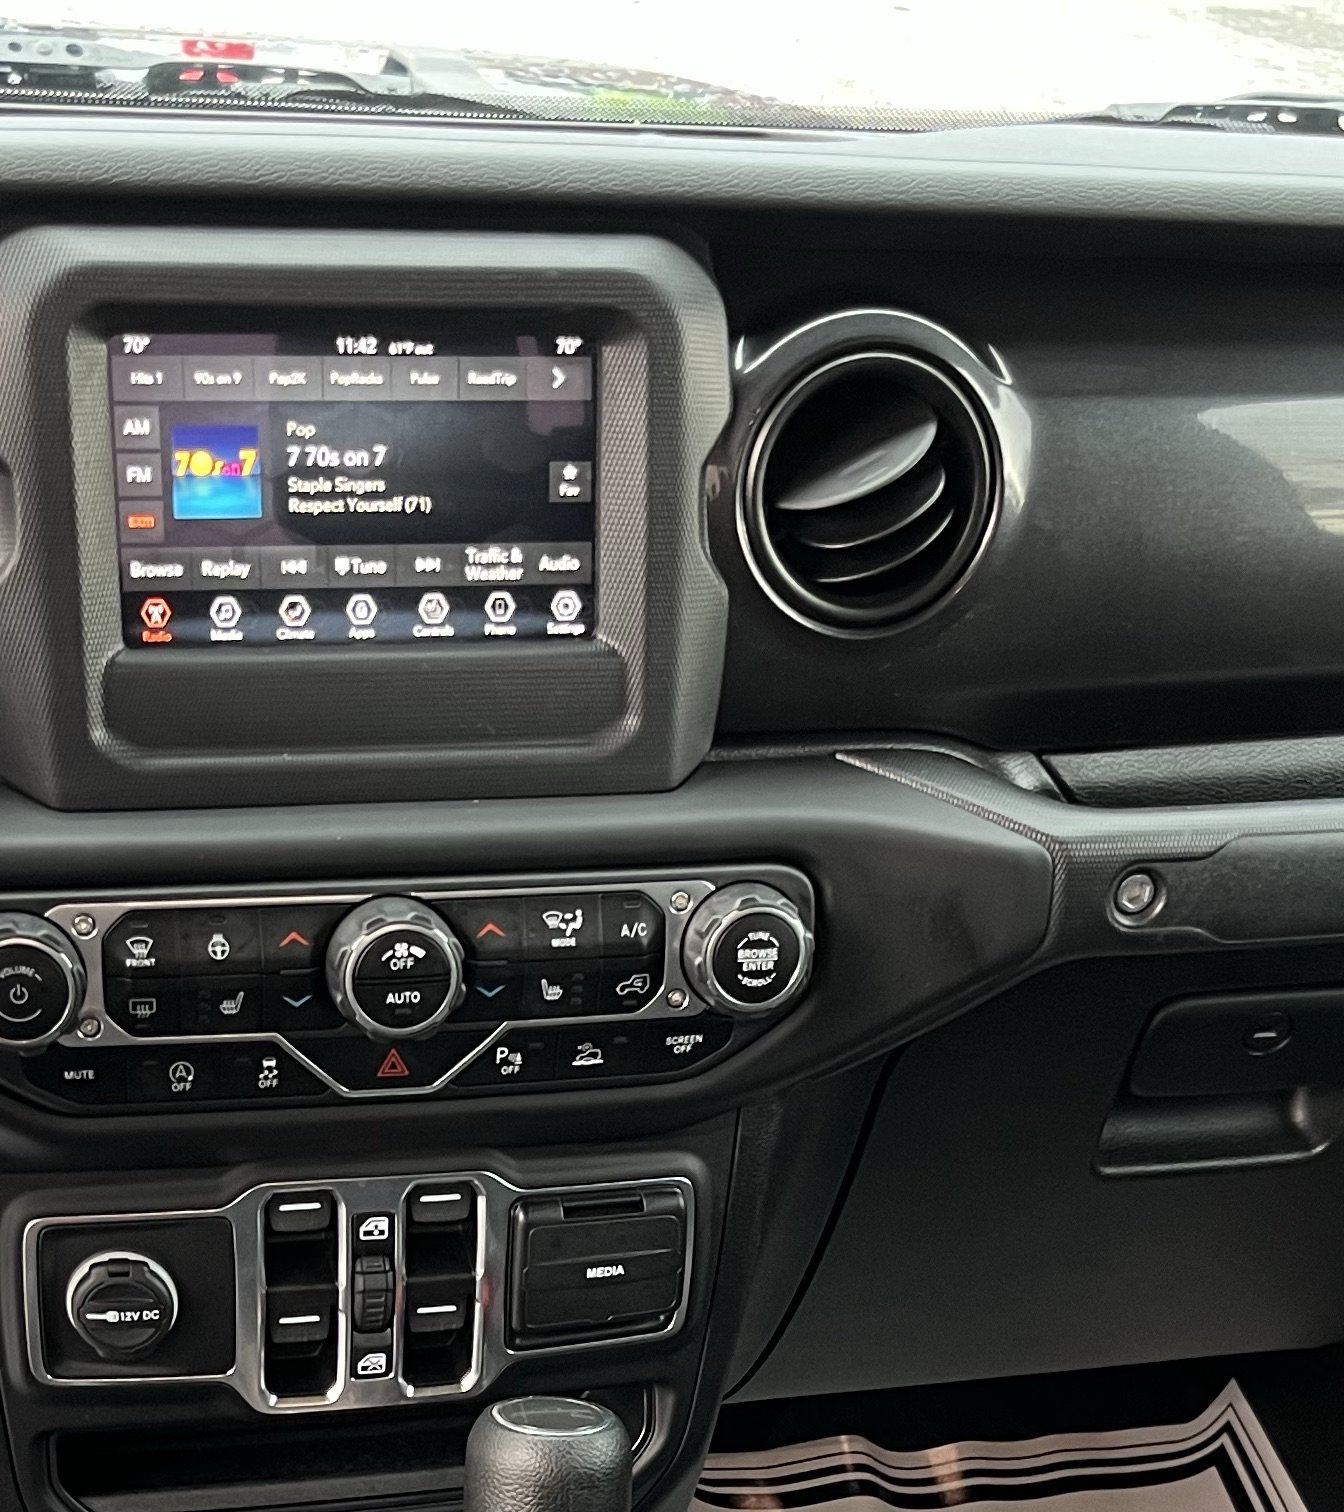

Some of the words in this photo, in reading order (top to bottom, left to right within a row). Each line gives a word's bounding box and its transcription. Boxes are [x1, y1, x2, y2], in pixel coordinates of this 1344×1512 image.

[336, 336, 378, 355] 11:42
[123, 419, 150, 436] AM
[286, 421, 316, 439] Pop
[286, 446, 301, 467] 7
[304, 445, 340, 467] 70s
[343, 448, 369, 467] on
[372, 443, 388, 467] 7
[126, 466, 152, 483] FM
[287, 477, 332, 495] Staple
[334, 477, 386, 496] Singers
[559, 483, 580, 497] Fav
[288, 499, 346, 517] Respect
[347, 497, 403, 514] Yourself
[404, 497, 432, 515] (71)
[465, 547, 509, 564] Traffic
[511, 547, 523, 563] &
[539, 553, 581, 571] Audio
[129, 560, 184, 579] Browse
[201, 560, 251, 579] Replay
[351, 559, 387, 575] Tune
[465, 565, 523, 582] Weather
[141, 630, 173, 643] Radio
[484, 623, 517, 636] Phone
[620, 922, 648, 938] A/C
[551, 937, 576, 948] MODE
[737, 948, 778, 960] BROWSE
[126, 959, 156, 967] FRONT
[390, 958, 414, 971] OFF
[742, 961, 774, 971] ENTER
[386, 991, 421, 1005] AUTO
[665, 1034, 703, 1045] SCREEN
[673, 1044, 693, 1054] OFF
[64, 1069, 95, 1081] MUTE
[501, 1066, 521, 1076] OFF
[171, 1082, 192, 1093] OFF
[258, 1079, 279, 1090] OFF
[586, 1264, 625, 1279] MEDIA
[120, 1311, 141, 1321] 12V
[143, 1309, 160, 1320] DC
